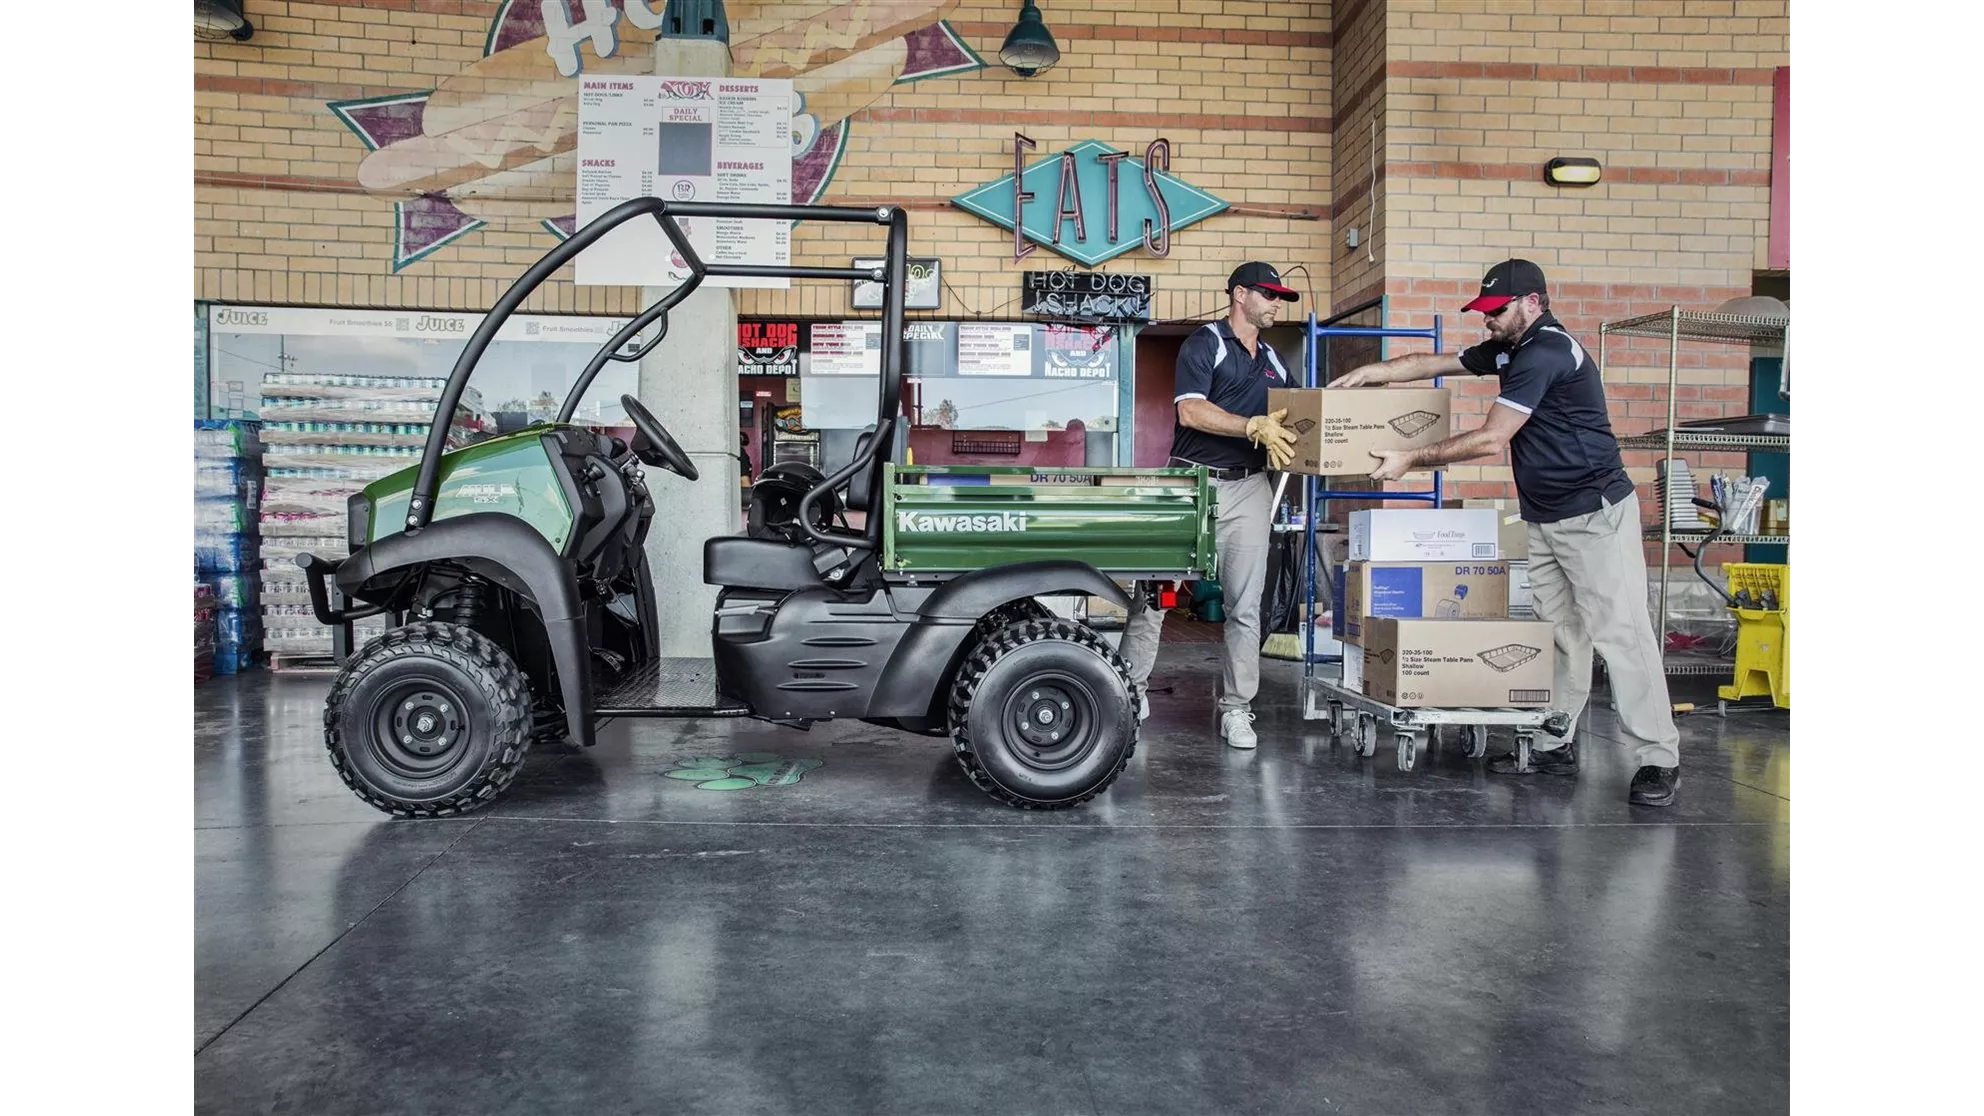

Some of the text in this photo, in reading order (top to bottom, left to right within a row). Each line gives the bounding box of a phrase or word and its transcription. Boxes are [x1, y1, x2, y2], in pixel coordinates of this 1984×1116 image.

[584, 82, 634, 90] MAIN ITEMS
[582, 159, 615, 167] SNACKS
[717, 162, 764, 170] BEVERAGES
[1014, 131, 1170, 265] EATS
[1028, 271, 1145, 293] HOT DOG
[217, 308, 268, 326] JUICE
[415, 315, 465, 332] JUICE
[542, 325, 558, 333] Fruit
[766, 323, 798, 346] DOG
[908, 324, 933, 332] DAILY
[742, 338, 788, 348] SHACK
[738, 365, 763, 375] ACHO
[766, 359, 797, 375] DEPOT
[1045, 361, 1111, 377] NACHO DEPOT
[1030, 474, 1091, 484] DR 70 50A
[899, 511, 1027, 532] Kawasaki
[1455, 566, 1506, 575] DR 70 50A
